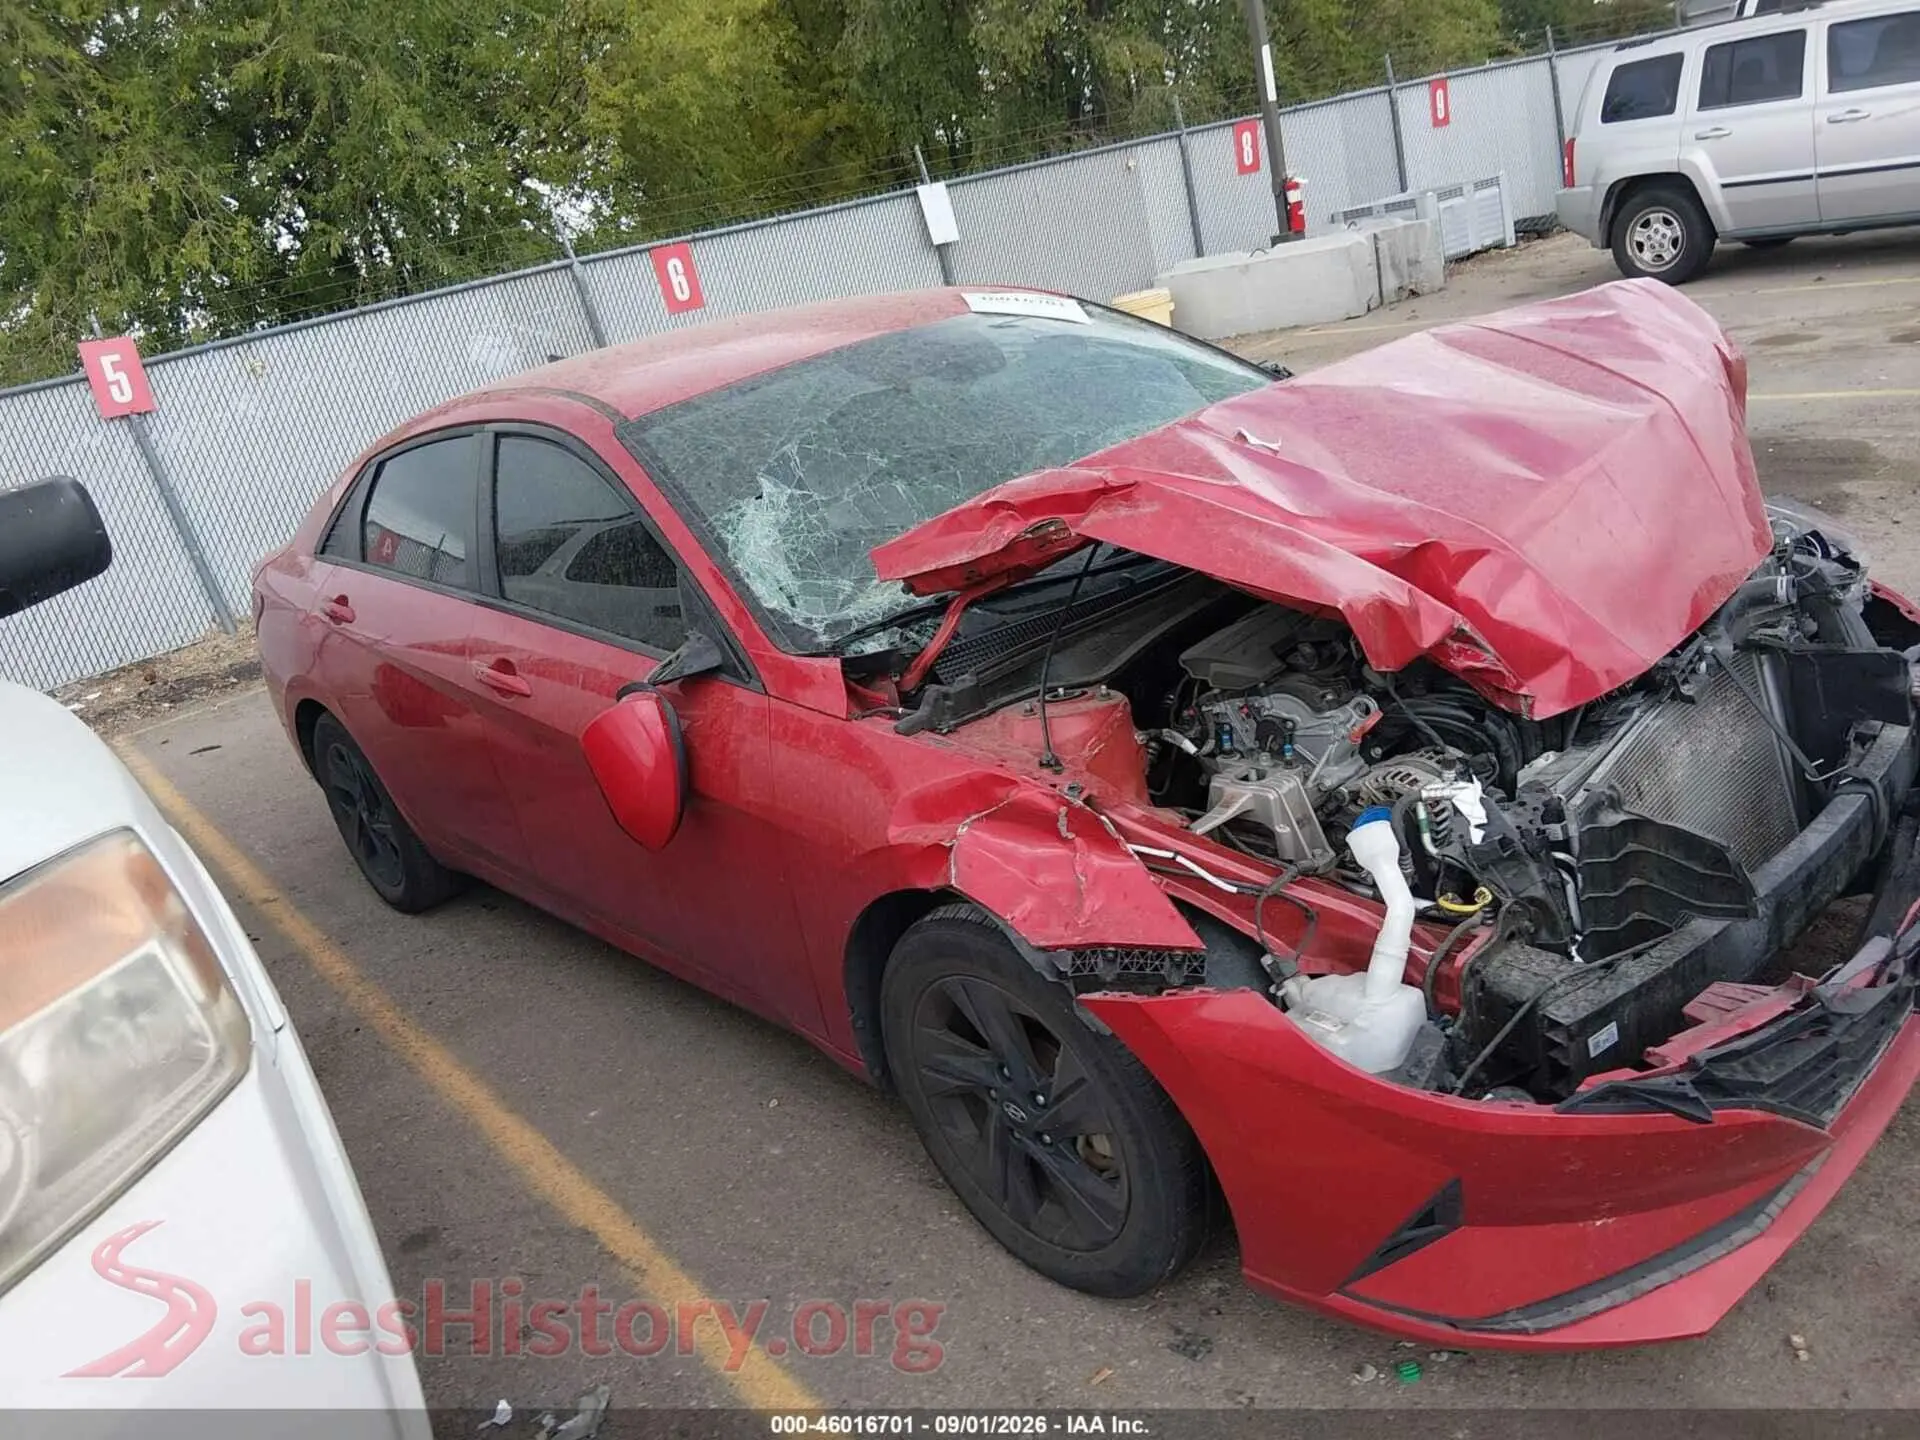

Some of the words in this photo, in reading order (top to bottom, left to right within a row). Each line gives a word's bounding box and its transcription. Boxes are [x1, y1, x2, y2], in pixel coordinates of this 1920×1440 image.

[1242, 131, 1253, 166] 8
[667, 257, 690, 302] 6
[100, 354, 133, 403] 5
